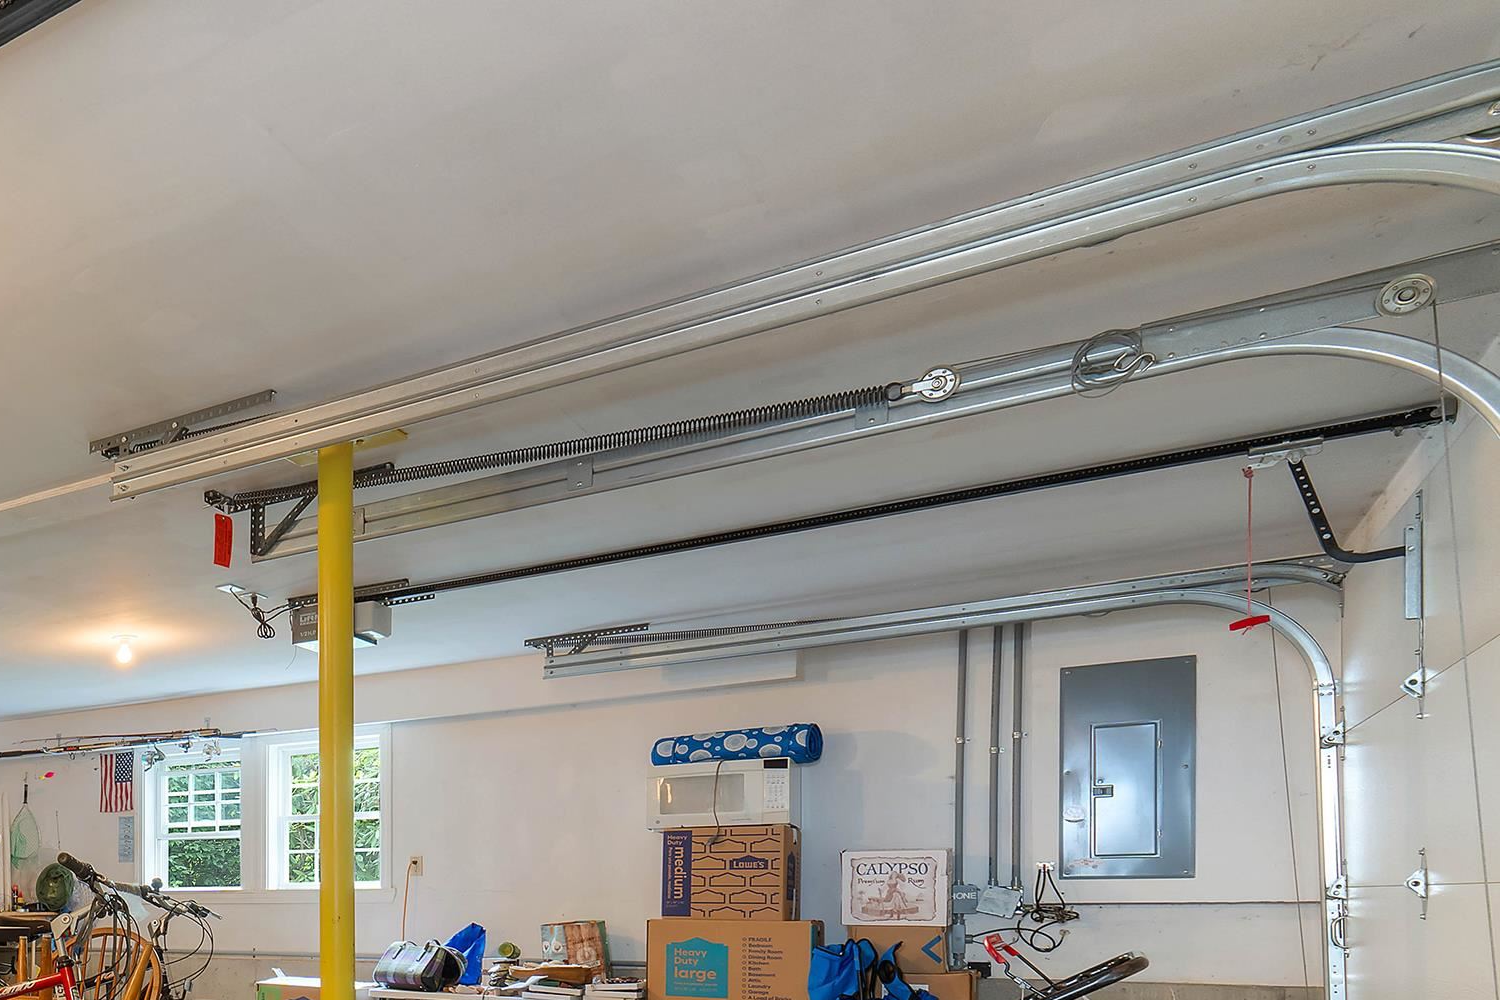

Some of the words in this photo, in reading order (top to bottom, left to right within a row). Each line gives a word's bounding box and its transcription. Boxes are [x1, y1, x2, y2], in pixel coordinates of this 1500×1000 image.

[733, 860, 765, 869] LOWE'S
[856, 862, 929, 876] CALYPSO
[674, 847, 687, 899] medium
[857, 878, 886, 887] Premium
[907, 878, 926, 888] Rum
[674, 947, 708, 958] Heavy
[674, 956, 698, 966] Duty
[674, 967, 717, 982] large
